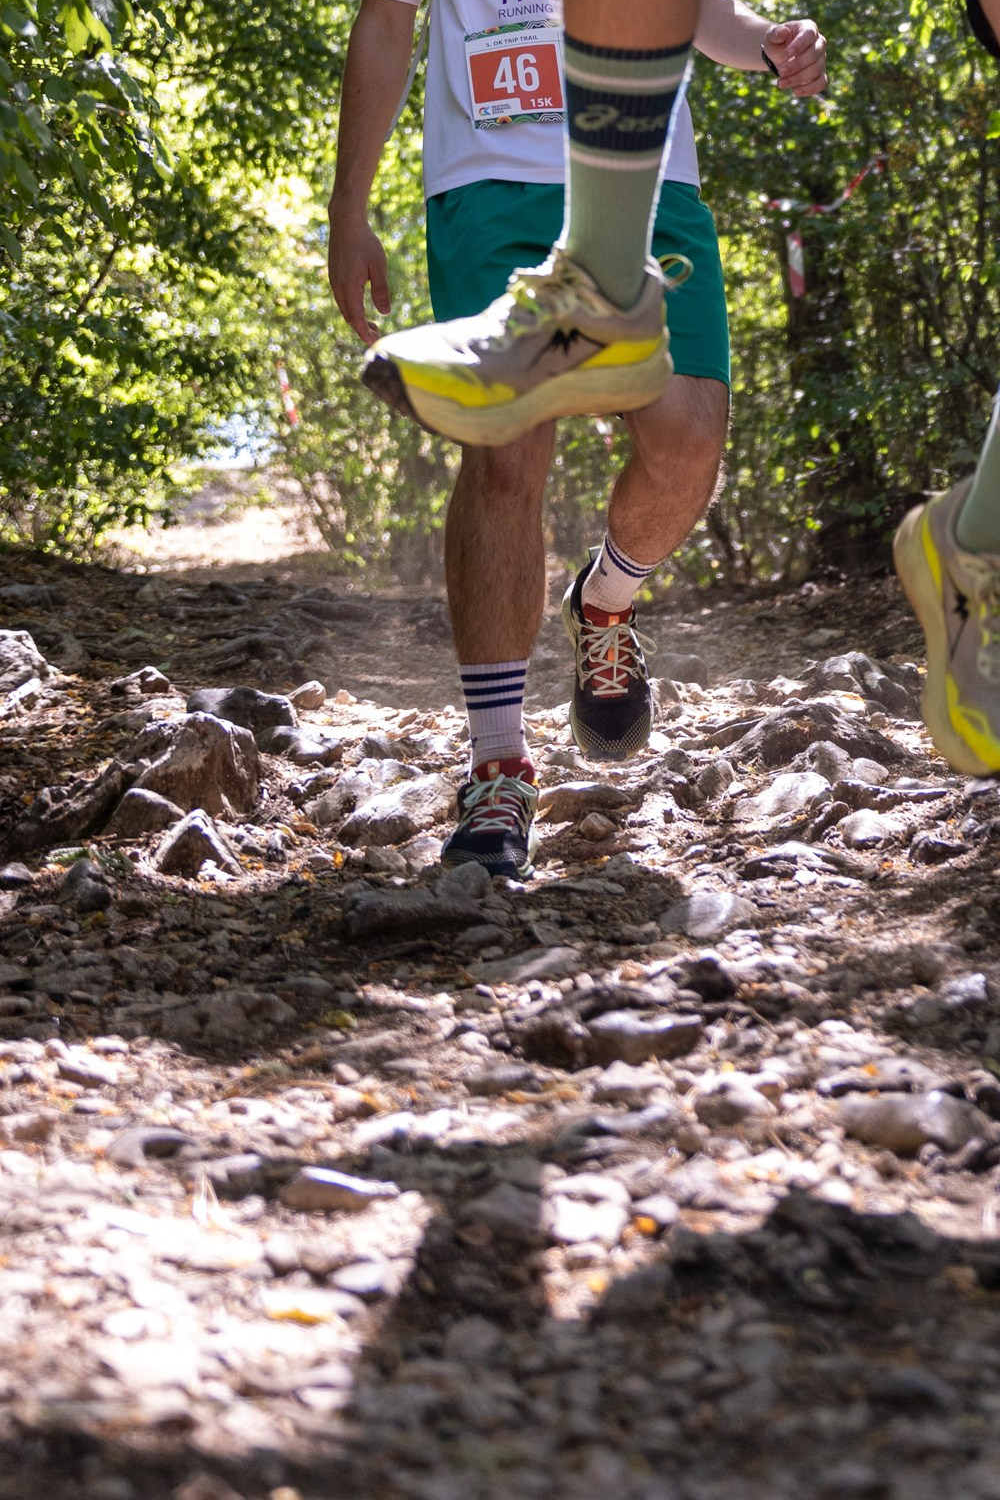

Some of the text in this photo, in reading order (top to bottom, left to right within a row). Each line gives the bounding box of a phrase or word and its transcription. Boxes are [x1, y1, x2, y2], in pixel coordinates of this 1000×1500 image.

[497, 3, 554, 20] RUNNING
[504, 37, 519, 45] TRIP
[519, 34, 538, 42] TRAIL
[493, 53, 540, 94] 46
[530, 97, 554, 108] 15K
